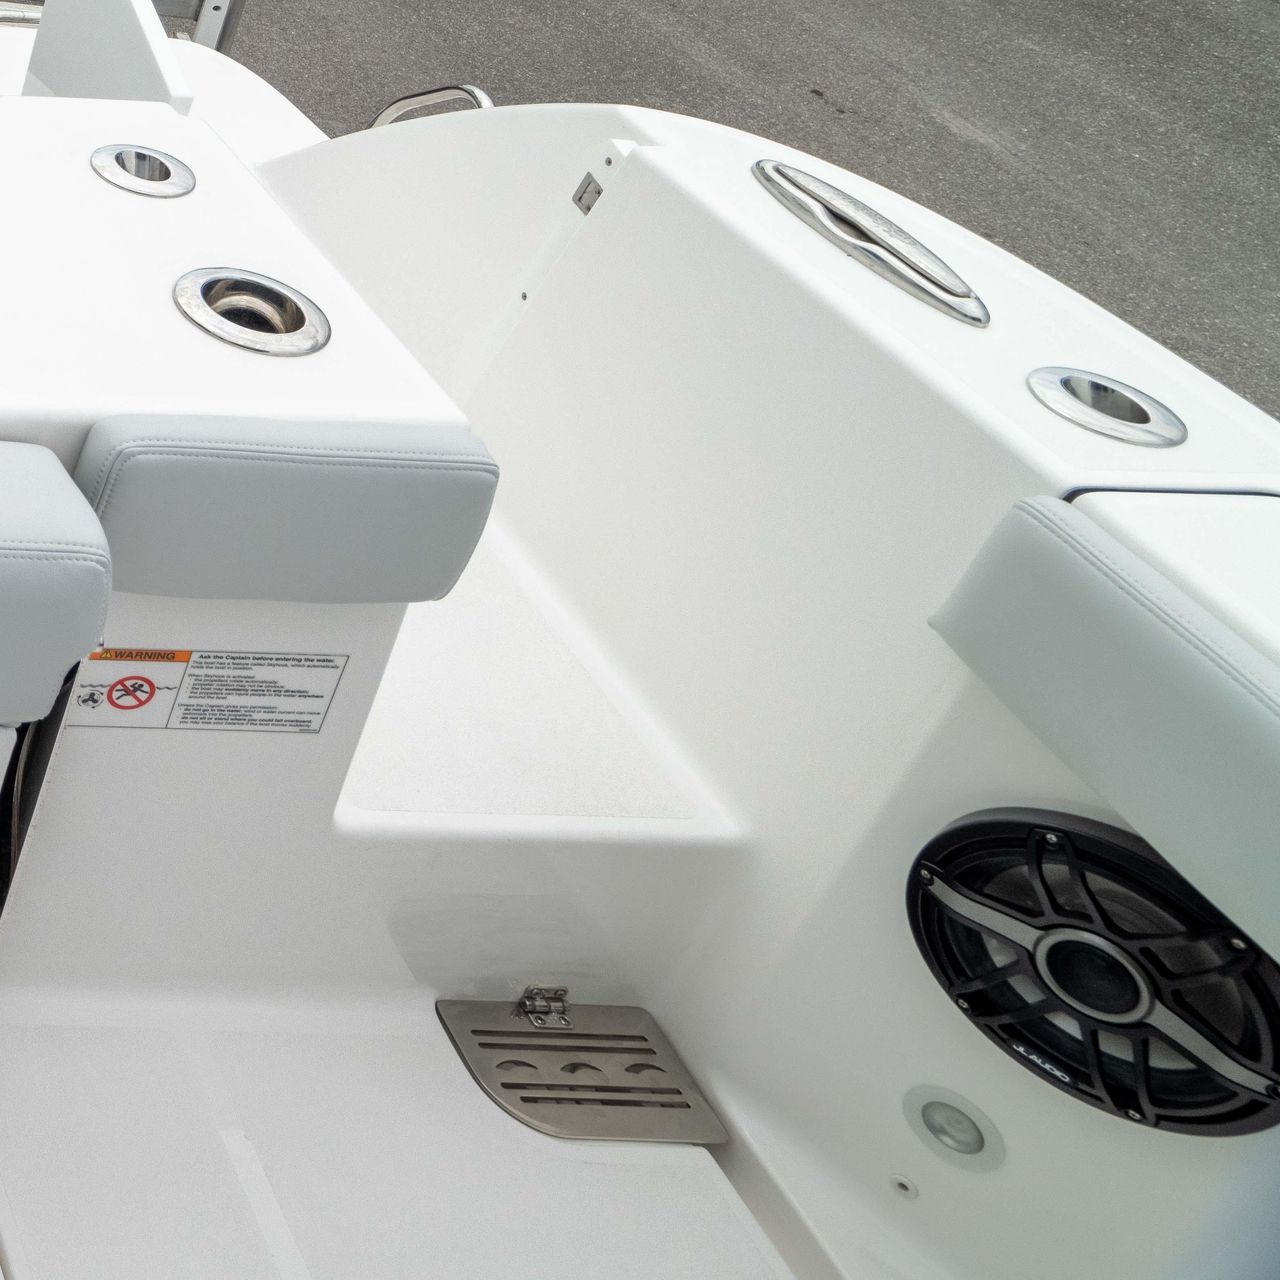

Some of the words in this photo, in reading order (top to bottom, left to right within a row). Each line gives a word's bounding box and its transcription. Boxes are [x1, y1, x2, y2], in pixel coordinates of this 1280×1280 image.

[114, 650, 177, 660] WARNING
[1012, 1044, 1028, 1056] JL
[1028, 1055, 1070, 1082] AUDIO
